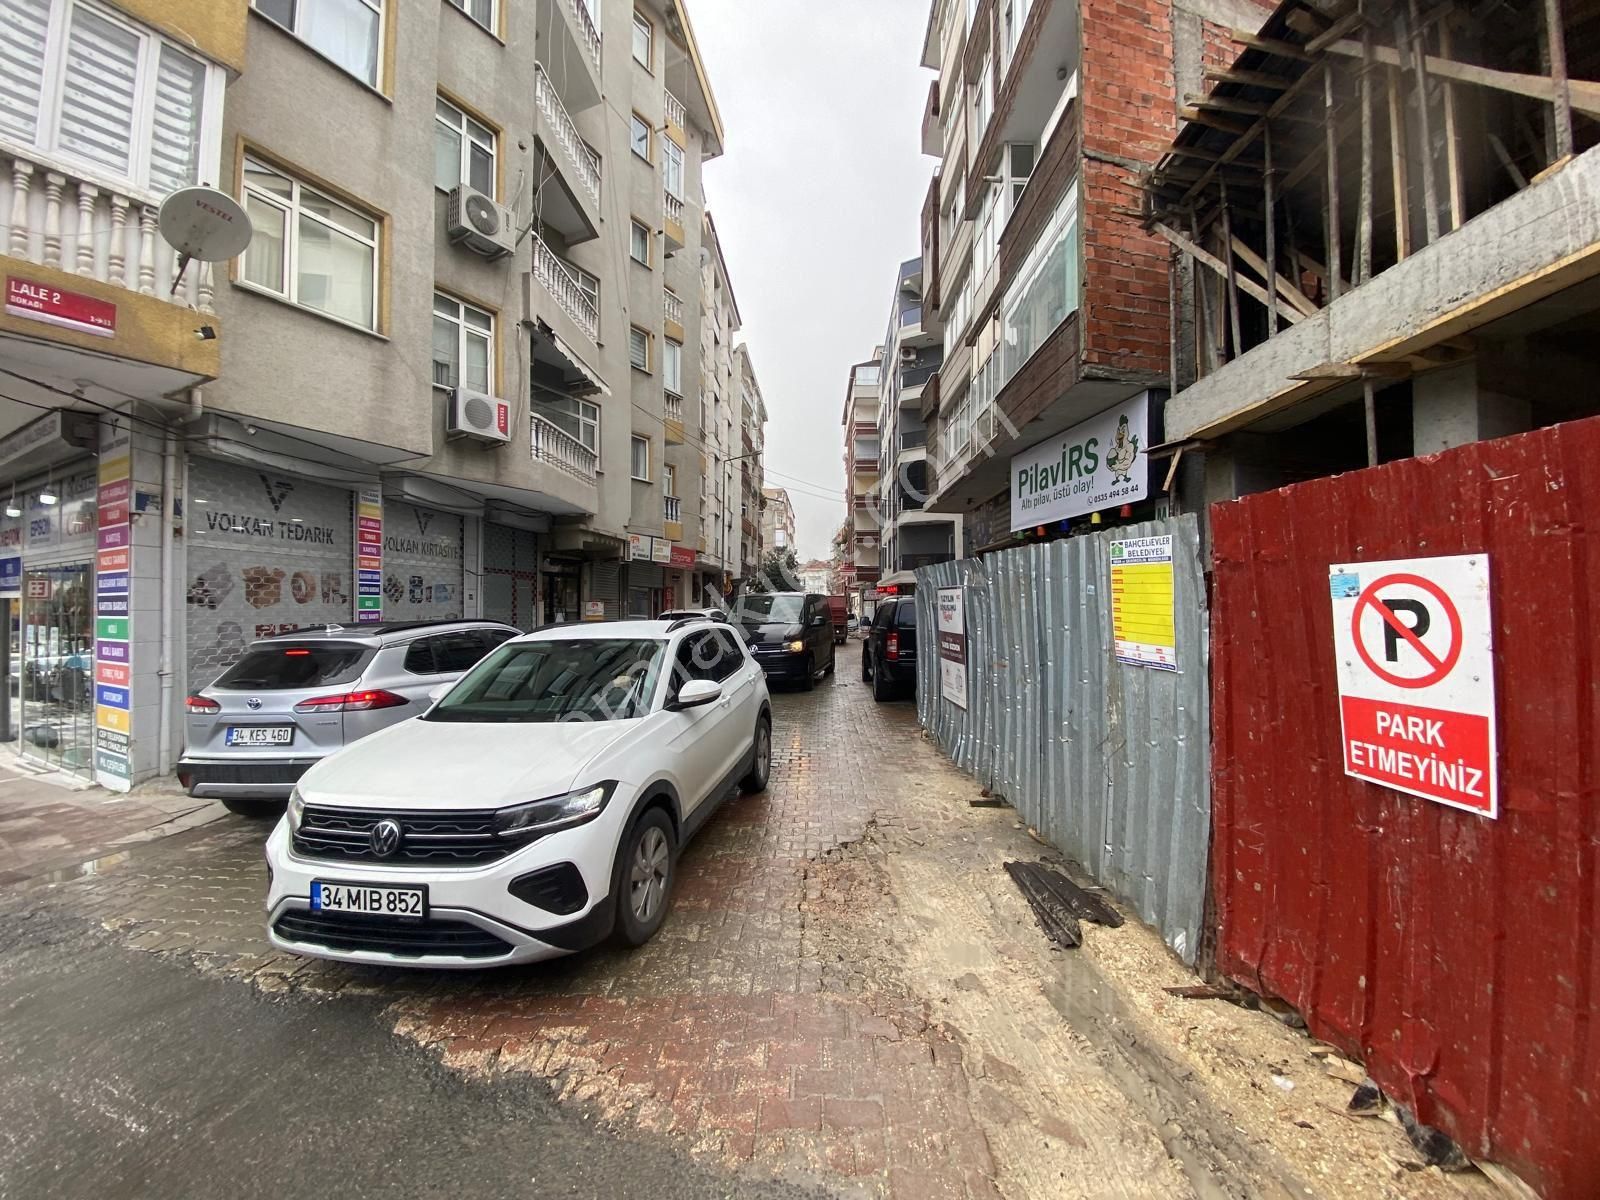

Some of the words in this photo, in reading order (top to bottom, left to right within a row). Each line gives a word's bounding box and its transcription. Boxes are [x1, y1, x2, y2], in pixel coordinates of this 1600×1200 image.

[196, 199, 233, 223] VESTEL
[10, 280, 48, 301] LALE
[52, 292, 61, 305] 2
[1017, 437, 1100, 500] PilavİRS
[1033, 490, 1053, 511] pilav,
[1053, 484, 1072, 502] üstü
[1073, 475, 1095, 495] olay!
[1093, 493, 1108, 504] 0535
[1109, 489, 1120, 499] 494
[1121, 486, 1129, 496] 58
[1130, 484, 1139, 493] 44
[206, 510, 275, 538] VOLKAN
[234, 729, 244, 741] 34
[249, 729, 267, 741] KES
[271, 729, 289, 741] 460
[1375, 710, 1446, 749] PARK
[1350, 740, 1485, 798] ETMEYİNİZ
[321, 887, 342, 909] 34
[346, 888, 382, 911] MIB
[386, 891, 421, 914] 852
